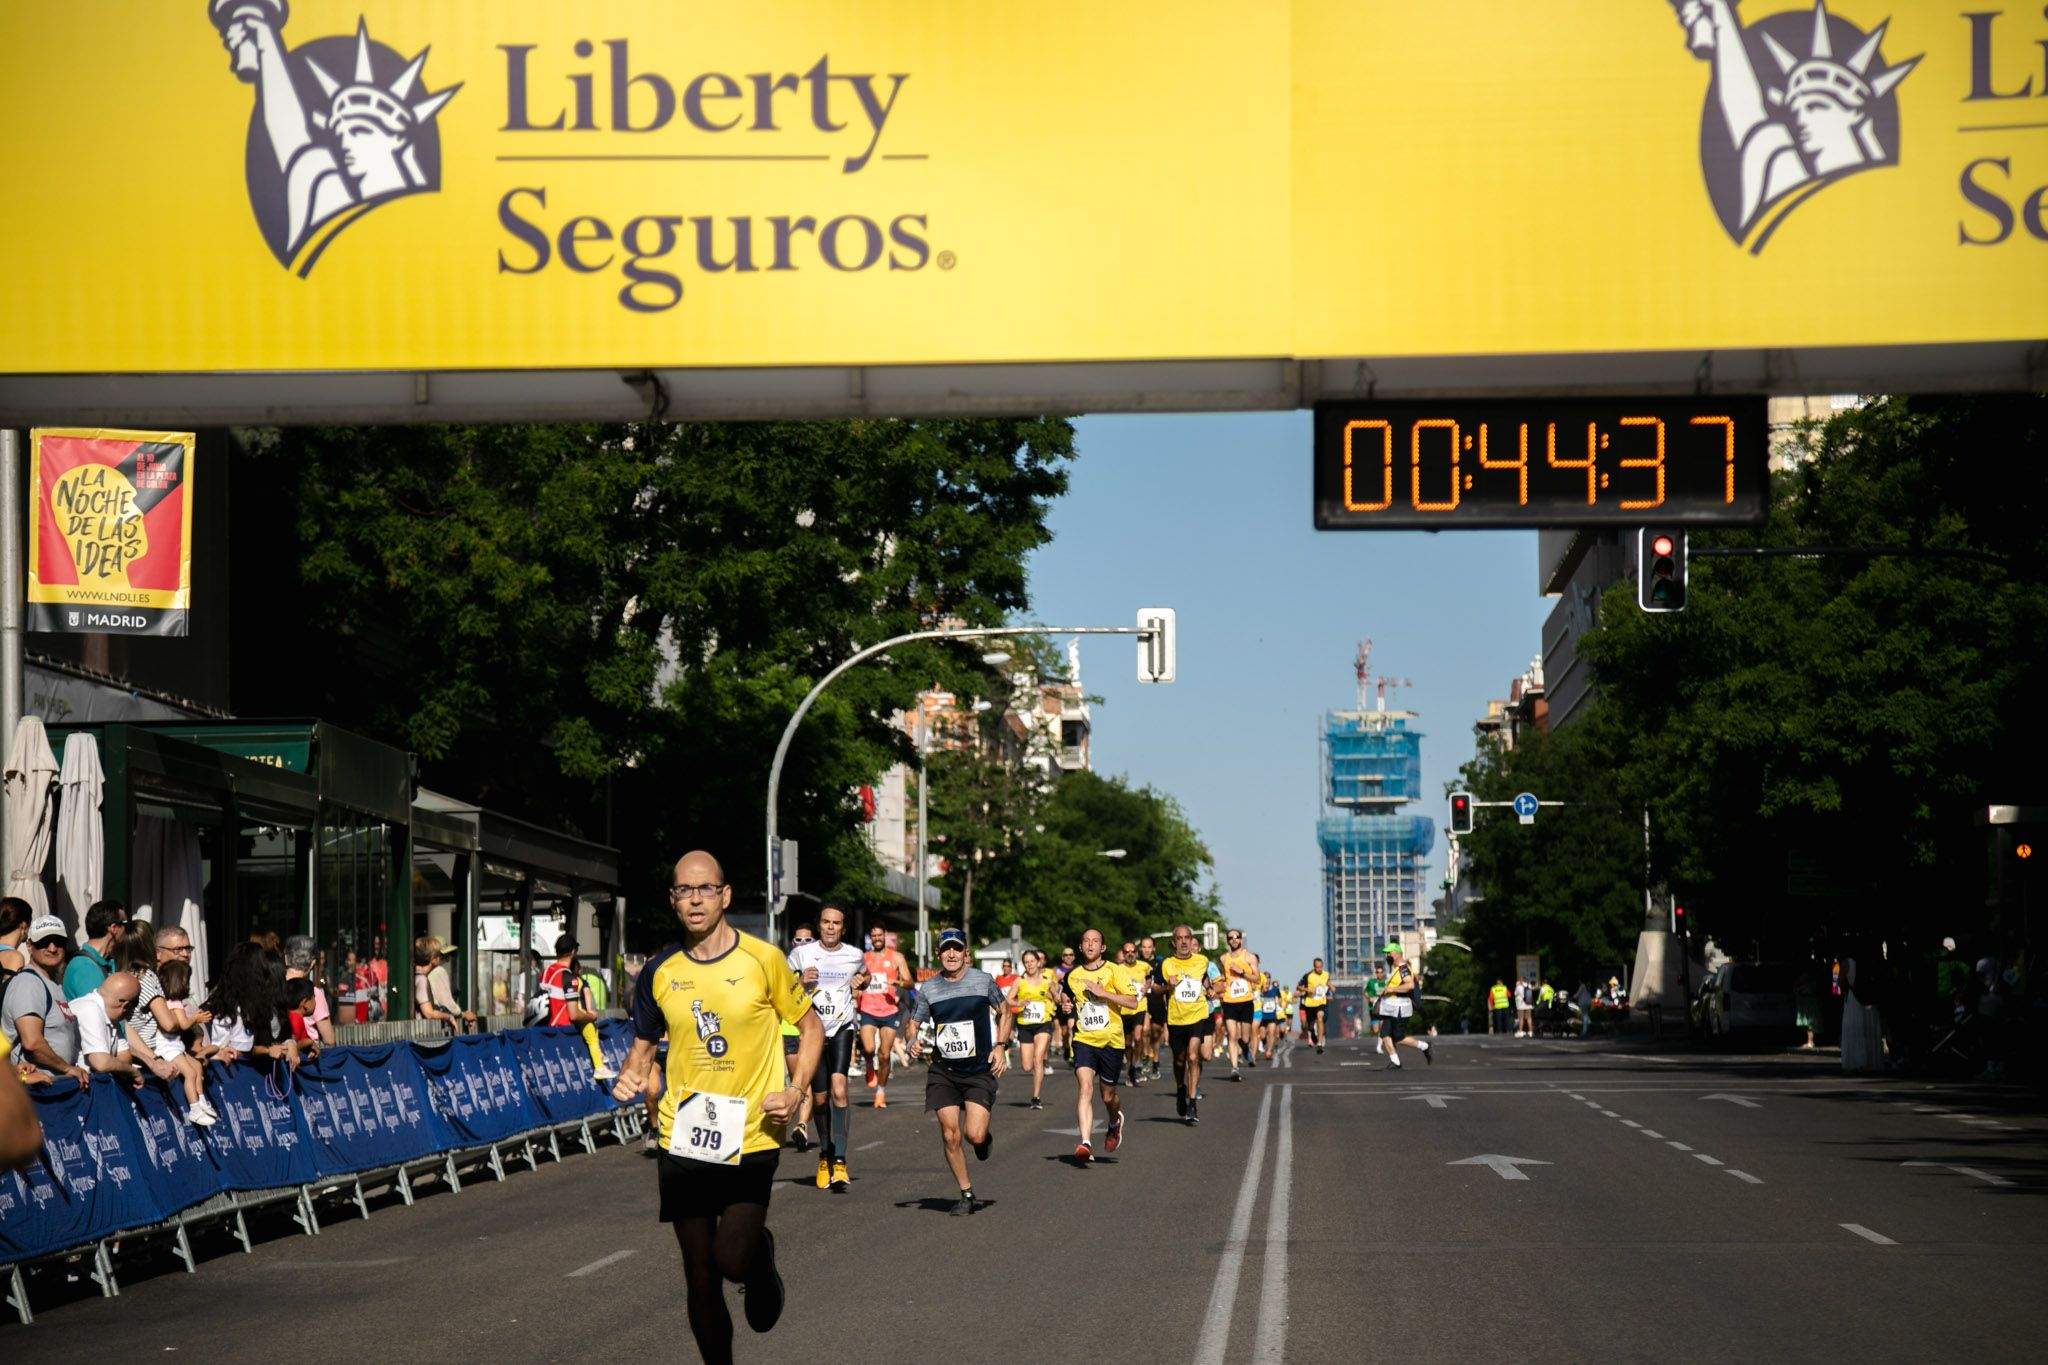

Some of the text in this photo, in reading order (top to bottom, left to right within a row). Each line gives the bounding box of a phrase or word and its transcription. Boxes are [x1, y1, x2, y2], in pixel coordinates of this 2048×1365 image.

[496, 38, 910, 174] Liberty
[498, 186, 931, 314] Seguros
[1343, 415, 1735, 512] 00:44:37
[81, 468, 106, 488] LA
[56, 476, 132, 515] NOCHE
[66, 514, 142, 543] DE LAS
[76, 539, 142, 579] IDEAS
[87, 613, 147, 628] MADRID
[1181, 990, 1196, 998] 1756
[819, 1004, 836, 1015] 567
[710, 1041, 724, 1053] 13
[944, 1040, 968, 1053] 2631
[690, 1126, 722, 1151] 379
